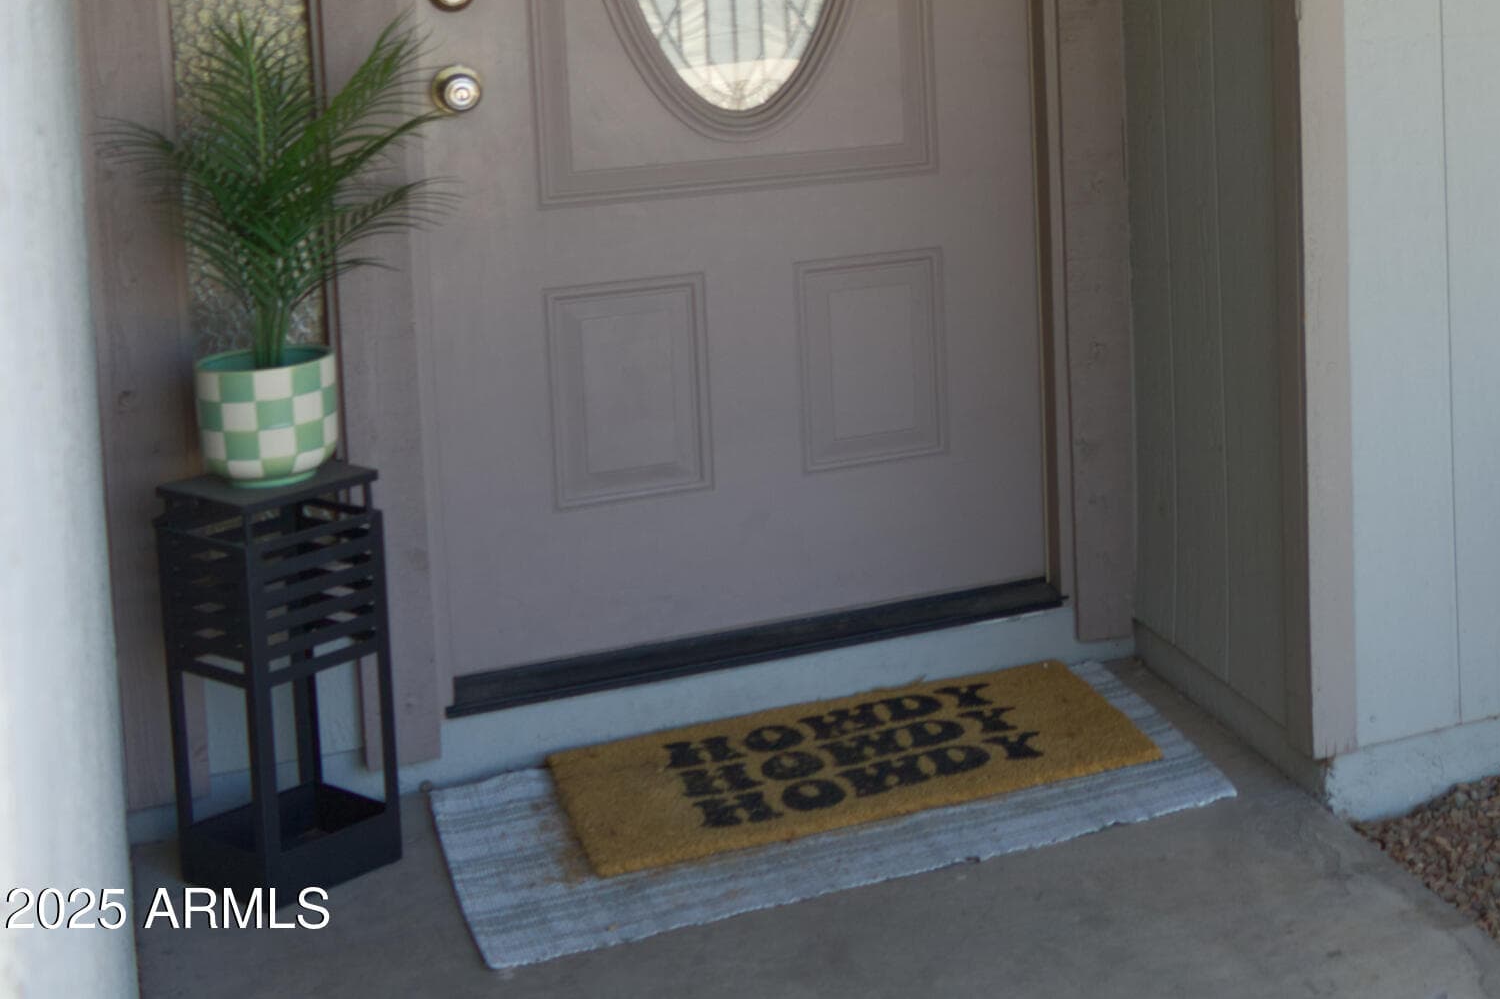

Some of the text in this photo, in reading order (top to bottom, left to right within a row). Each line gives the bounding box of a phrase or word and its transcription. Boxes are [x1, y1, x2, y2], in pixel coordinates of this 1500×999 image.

[663, 682, 994, 768] HOWDY
[678, 707, 1022, 797] HOWDY
[693, 730, 1044, 828] HOWDY
